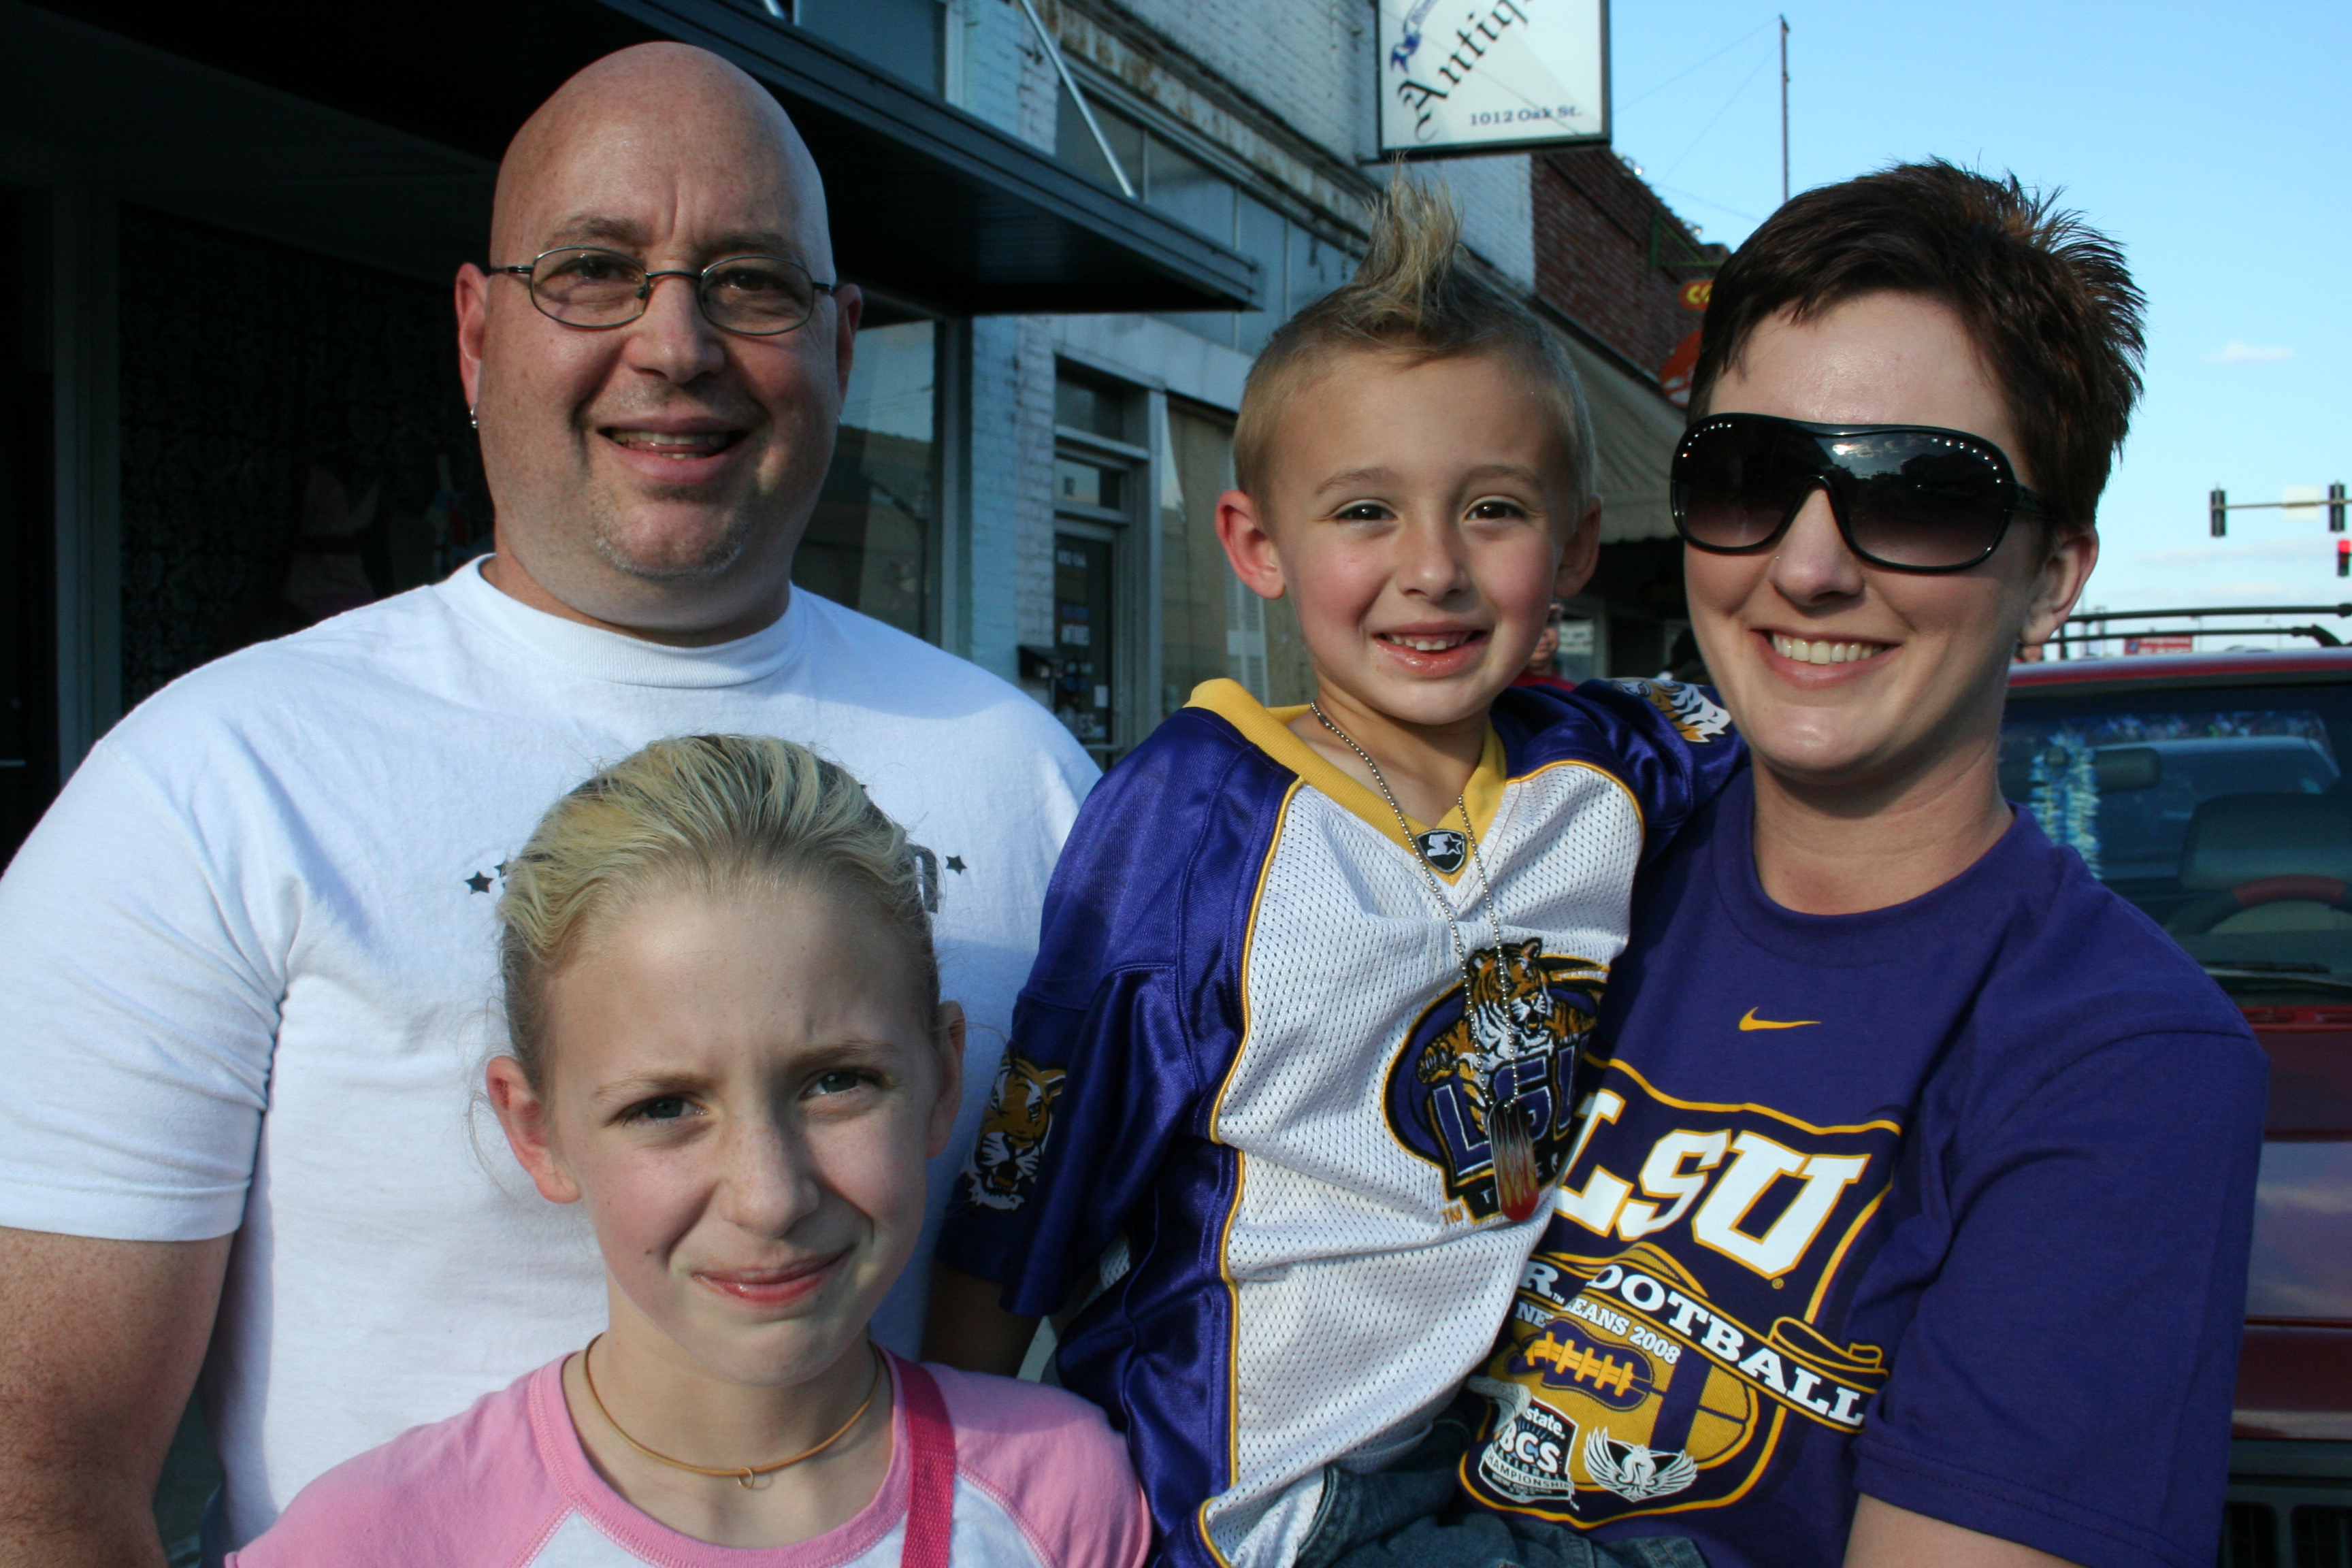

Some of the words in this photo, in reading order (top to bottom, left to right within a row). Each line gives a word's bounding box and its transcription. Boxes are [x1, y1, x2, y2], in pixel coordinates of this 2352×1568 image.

[1396, 0, 1530, 144] Antiq
[1470, 110, 1513, 126] 1012
[1518, 107, 1552, 121] Oak
[1557, 105, 1583, 118] St.
[1556, 1089, 1872, 1279] LSU
[1566, 1297, 1631, 1336] EANS
[1629, 1325, 1682, 1365] 2008
[1586, 1264, 1867, 1428] OOTBALL
[1499, 1420, 1561, 1473] BCS
[1524, 1407, 1566, 1440] state.
